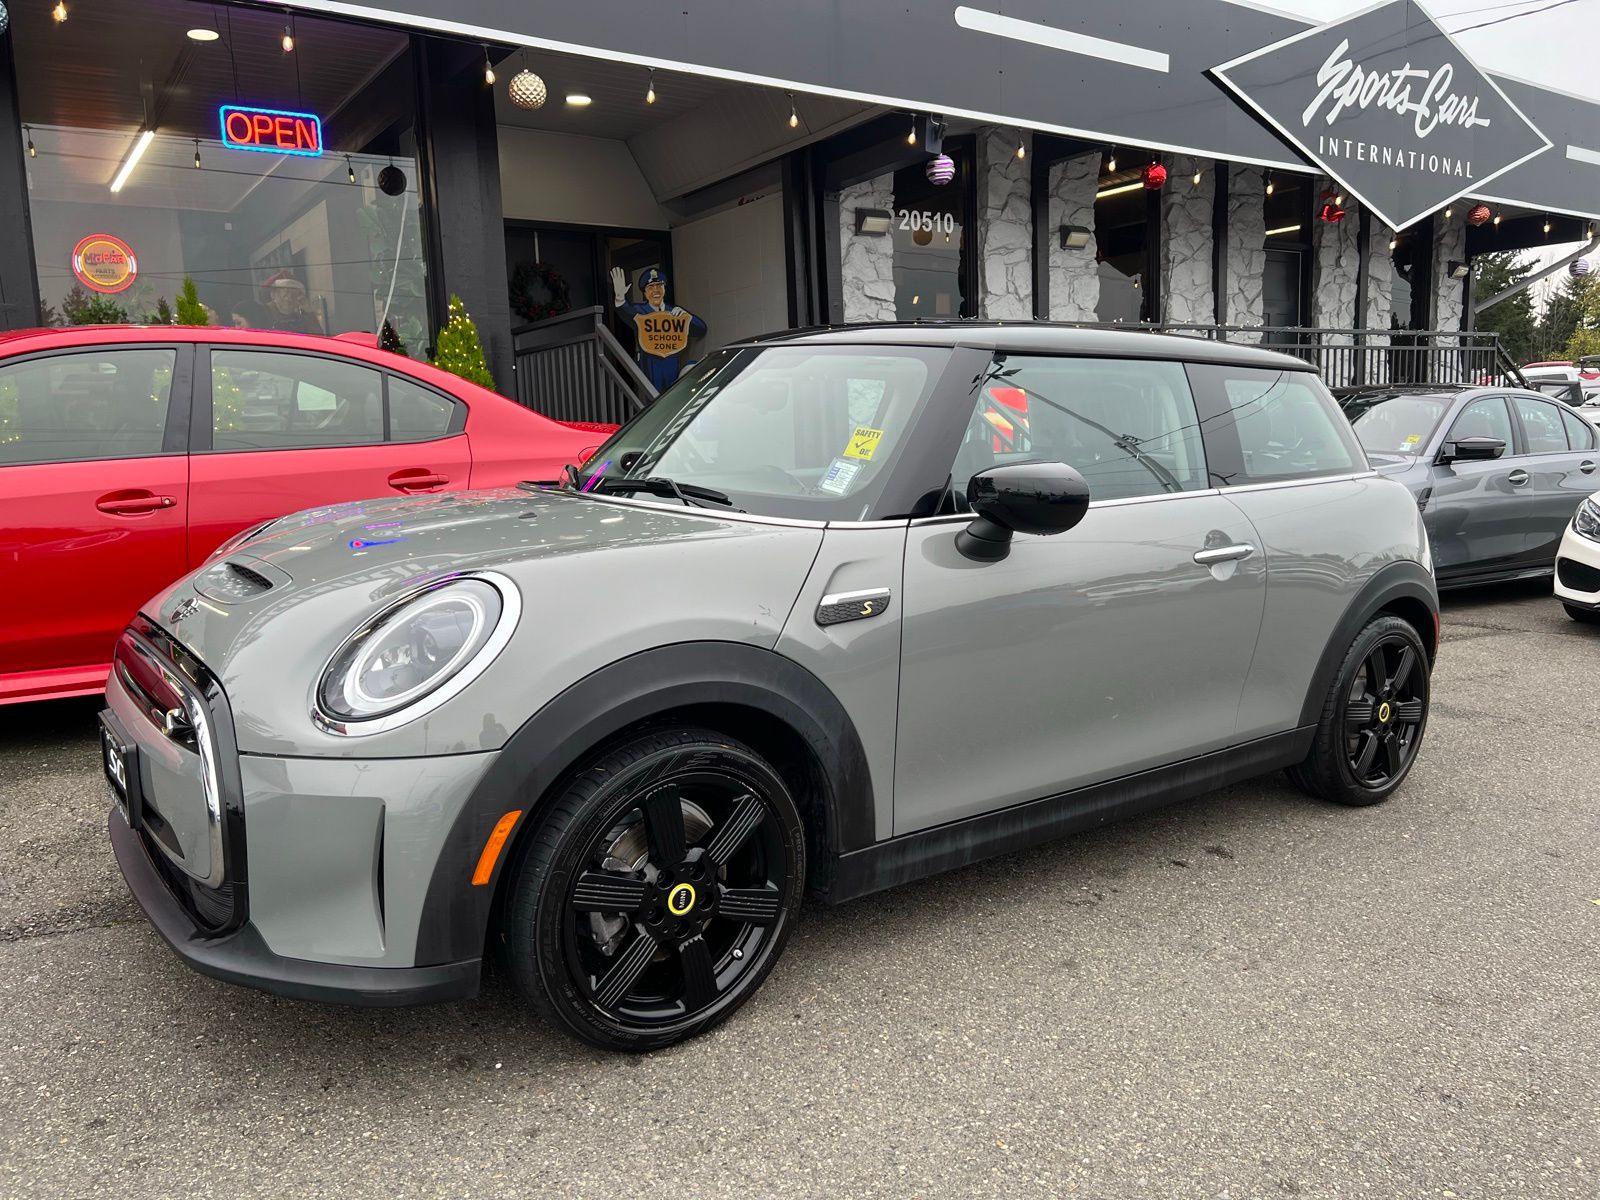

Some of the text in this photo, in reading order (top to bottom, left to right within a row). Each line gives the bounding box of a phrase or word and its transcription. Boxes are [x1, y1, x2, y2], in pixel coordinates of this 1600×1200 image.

[1302, 38, 1491, 139] Sports Cars
[226, 112, 317, 150] OPEN
[1319, 136, 1473, 178] INTERNATIONAL
[899, 209, 954, 234] 20510
[644, 318, 686, 333] SLOW
[648, 334, 683, 342] SCHOOL
[855, 428, 881, 439] SAFETY
[860, 600, 873, 616] S
